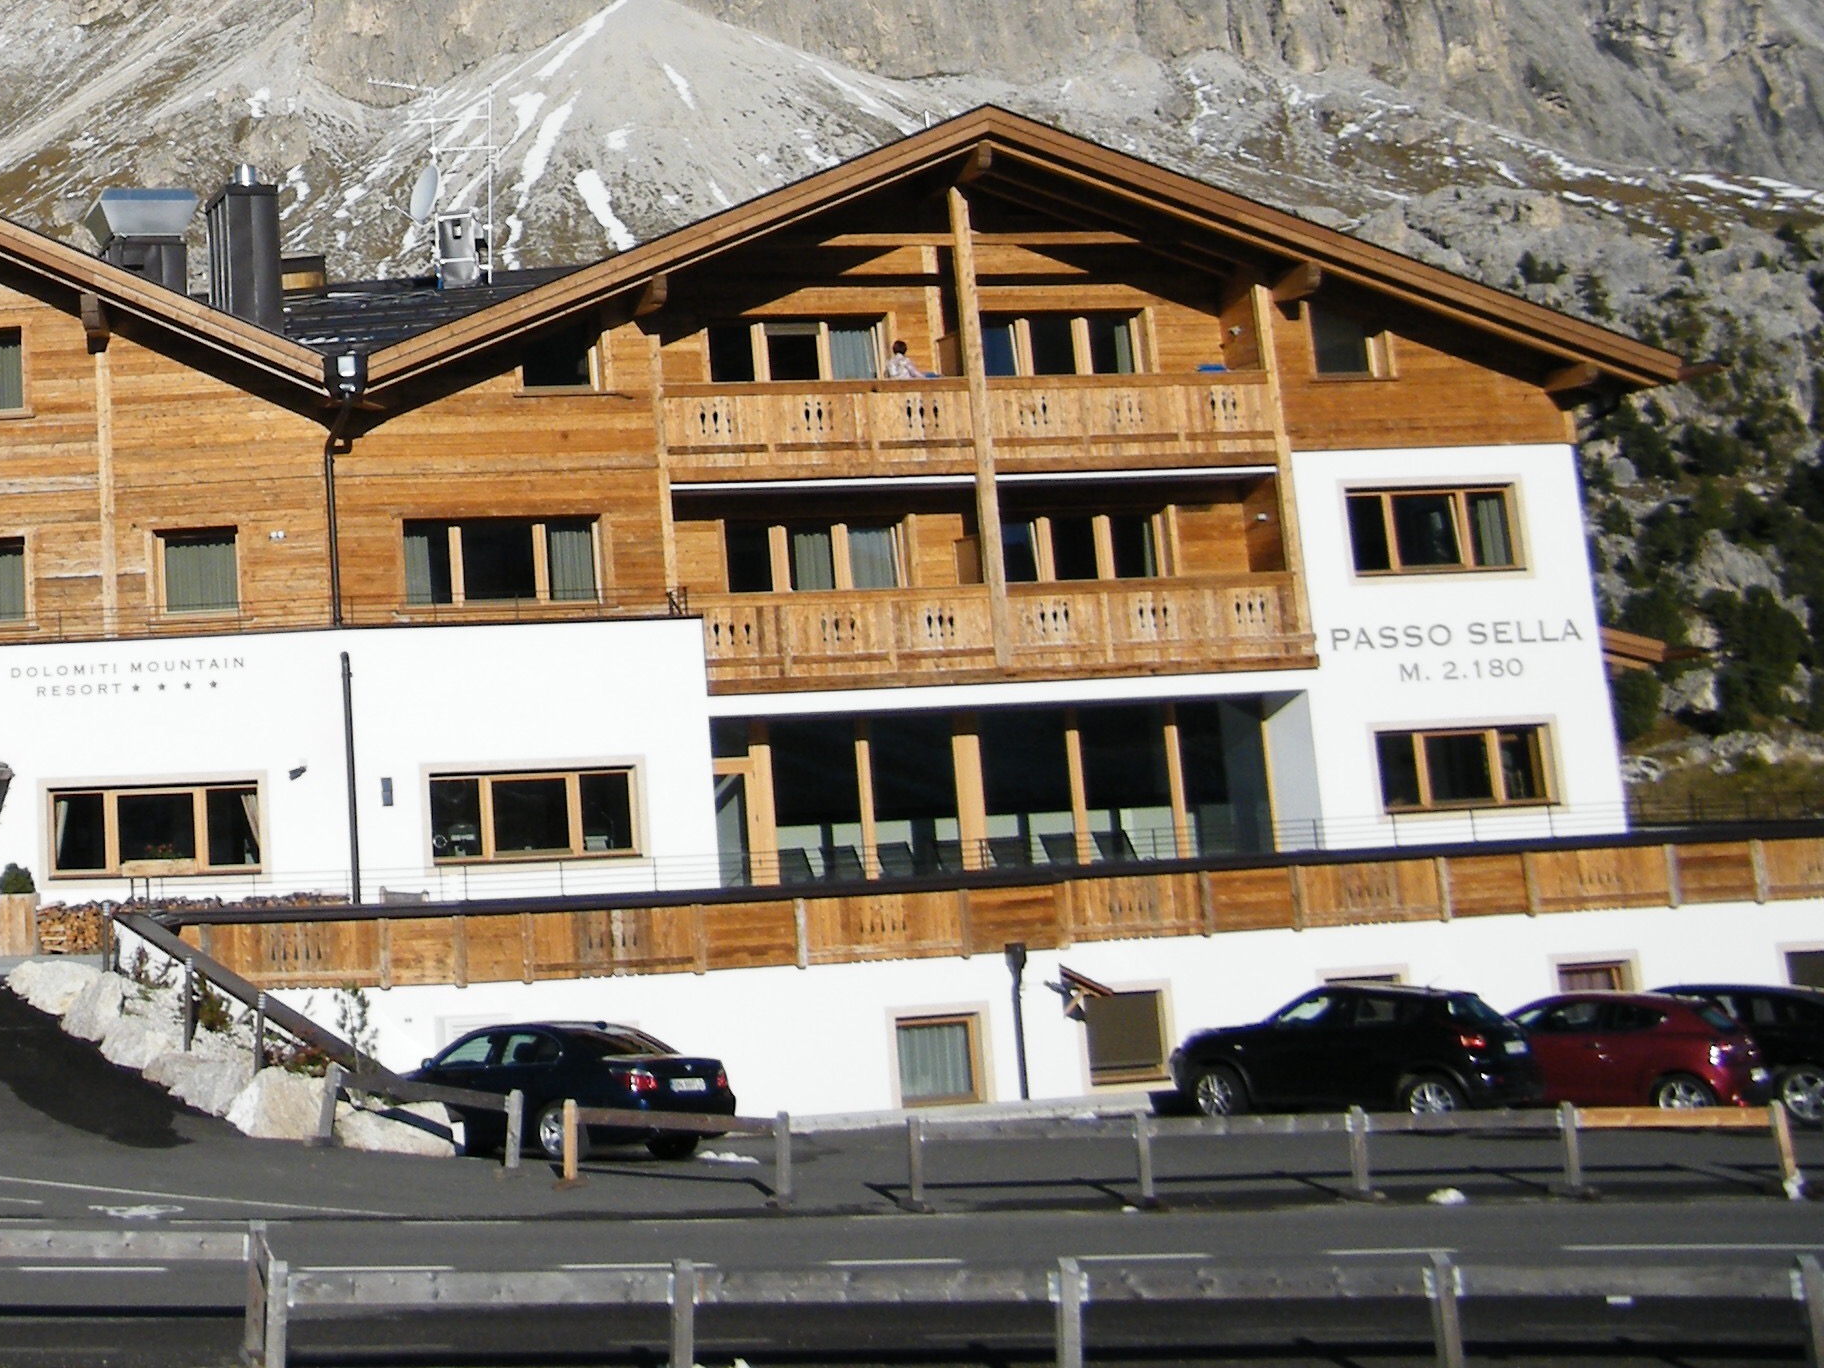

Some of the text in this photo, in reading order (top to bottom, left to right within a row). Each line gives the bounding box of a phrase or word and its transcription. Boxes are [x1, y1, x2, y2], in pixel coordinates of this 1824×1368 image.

[1329, 618, 1583, 651] PASSO SELLA
[10, 657, 245, 679] DOLOMITI MOUNTAIN
[1398, 657, 1524, 683] M. 2.180
[36, 683, 123, 698] RESORT
